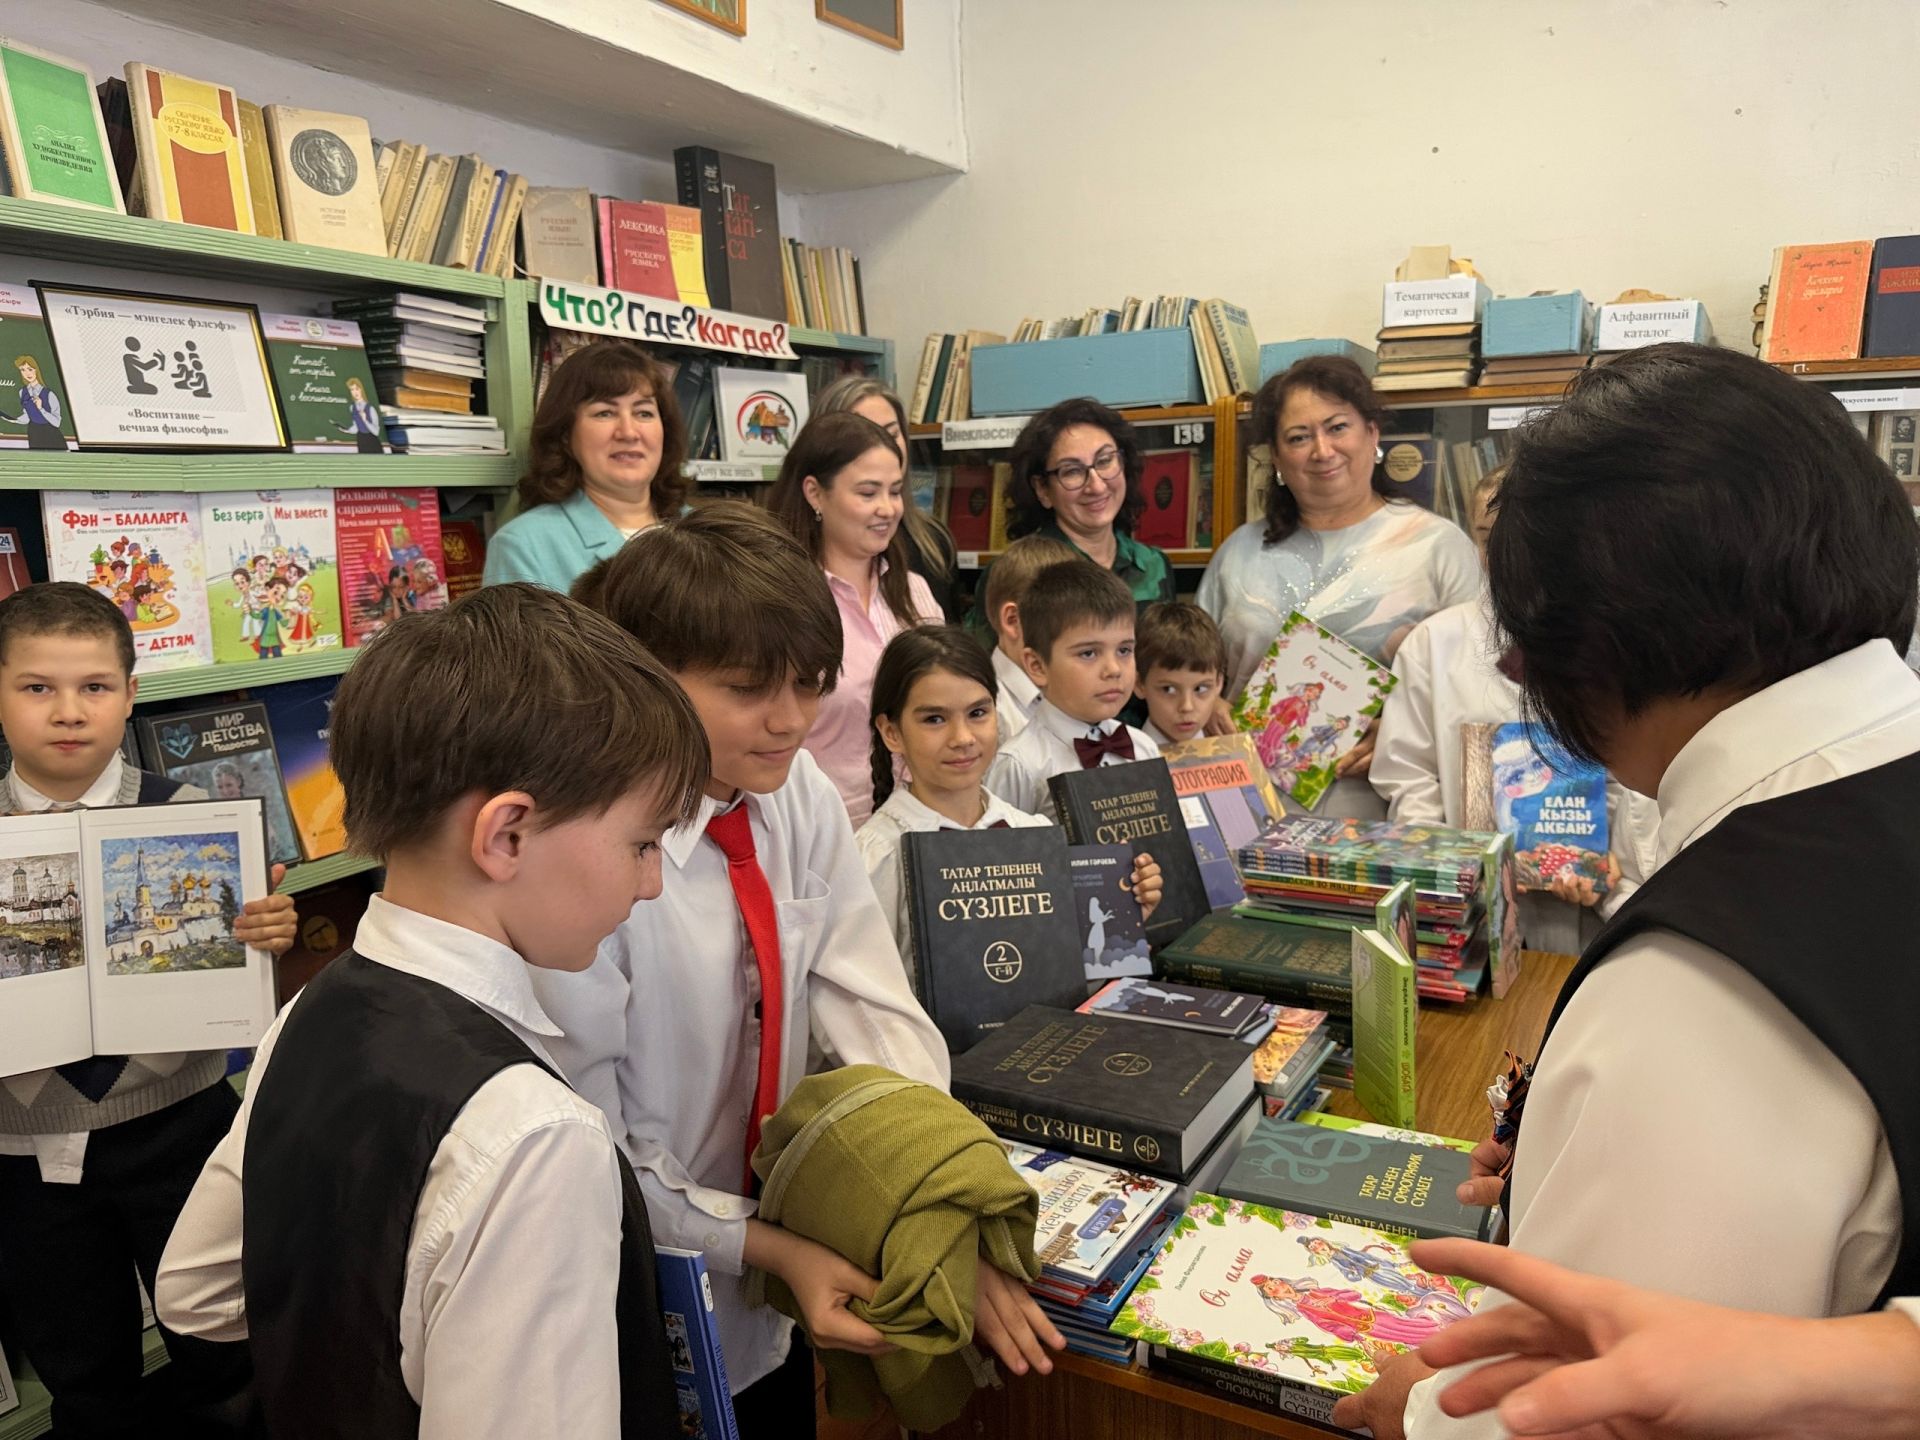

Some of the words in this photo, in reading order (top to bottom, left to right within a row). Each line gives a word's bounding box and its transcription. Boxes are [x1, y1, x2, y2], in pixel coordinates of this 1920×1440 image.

[619, 219, 666, 236] ЛЕКСИКА
[1394, 291, 1470, 302] Тематическая
[1403, 307, 1458, 318] картотека
[1608, 309, 1690, 324] Алфавитный
[1623, 329, 1672, 338] каталог
[127, 408, 200, 421] «Воспитание
[119, 423, 159, 433] вечная
[161, 422, 229, 436] философия»
[1174, 423, 1205, 445] 138
[115, 512, 189, 526] БАЛАЛАРГА
[212, 508, 232, 522] Без
[274, 506, 291, 519] Мы
[294, 507, 328, 519] вместе
[150, 634, 194, 651] ДЕТЯМ
[214, 712, 244, 728] МИР
[201, 723, 265, 747] ДЕТСТВА
[1091, 796, 1119, 811] ТАТАР
[1544, 796, 1586, 808] ЕЛАН
[1539, 808, 1592, 821] КЫЗЫ
[940, 866, 981, 880] ТАТАР
[996, 945, 1007, 962] 2
[1359, 1174, 1379, 1198] ТАТАР
[1216, 1380, 1274, 1406] СЛОВАРЬ
